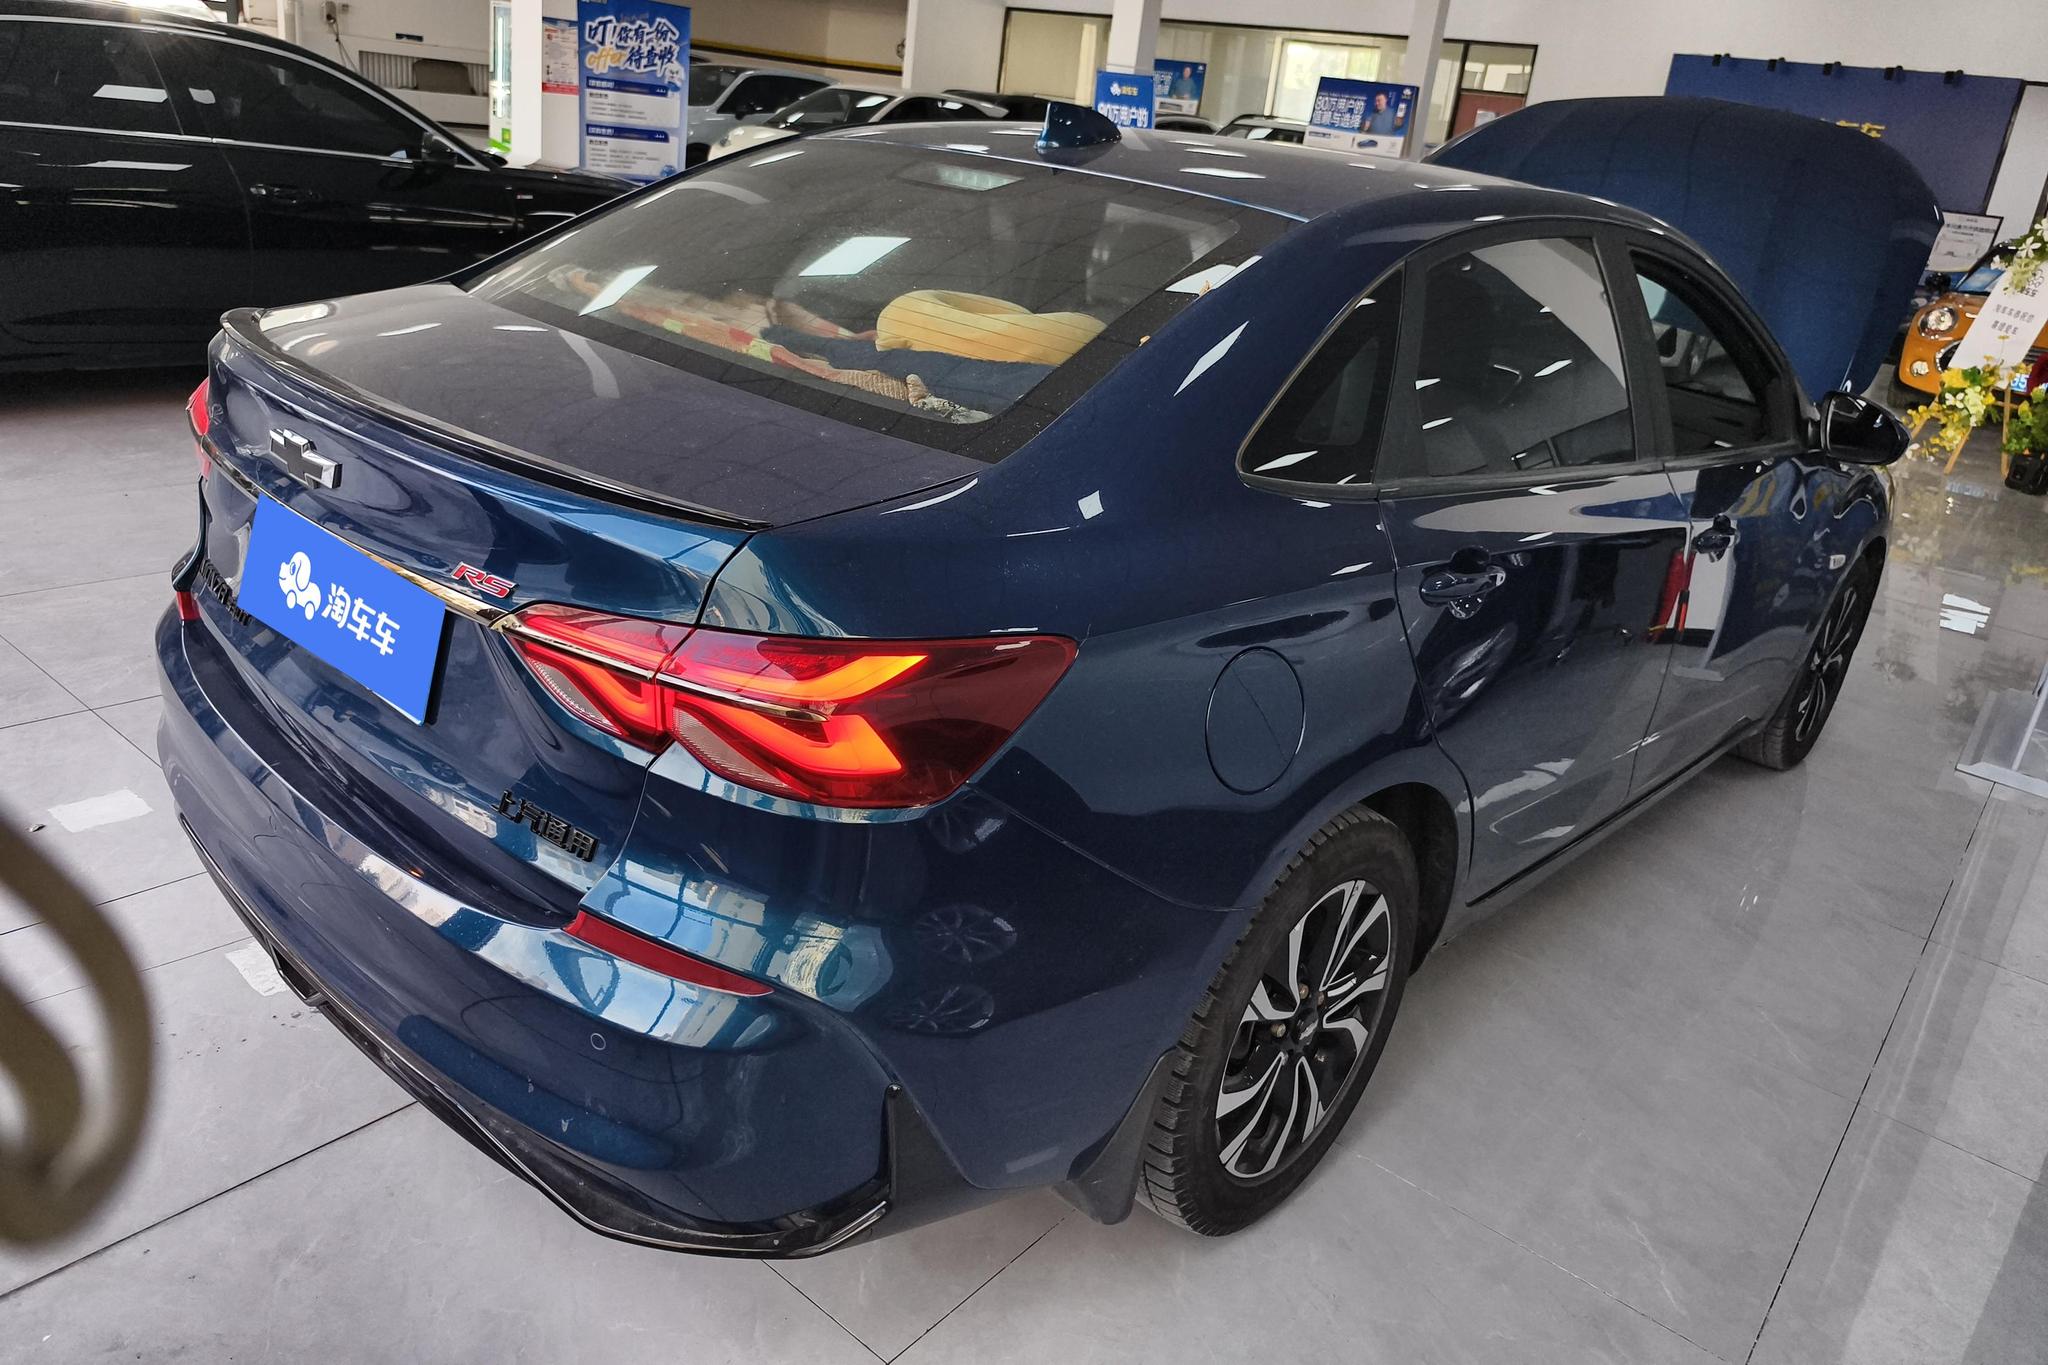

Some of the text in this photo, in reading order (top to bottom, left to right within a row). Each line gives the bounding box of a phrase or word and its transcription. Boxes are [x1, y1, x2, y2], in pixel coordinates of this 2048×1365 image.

[450, 561, 517, 599] RS
[491, 789, 599, 862] 上汽通用
